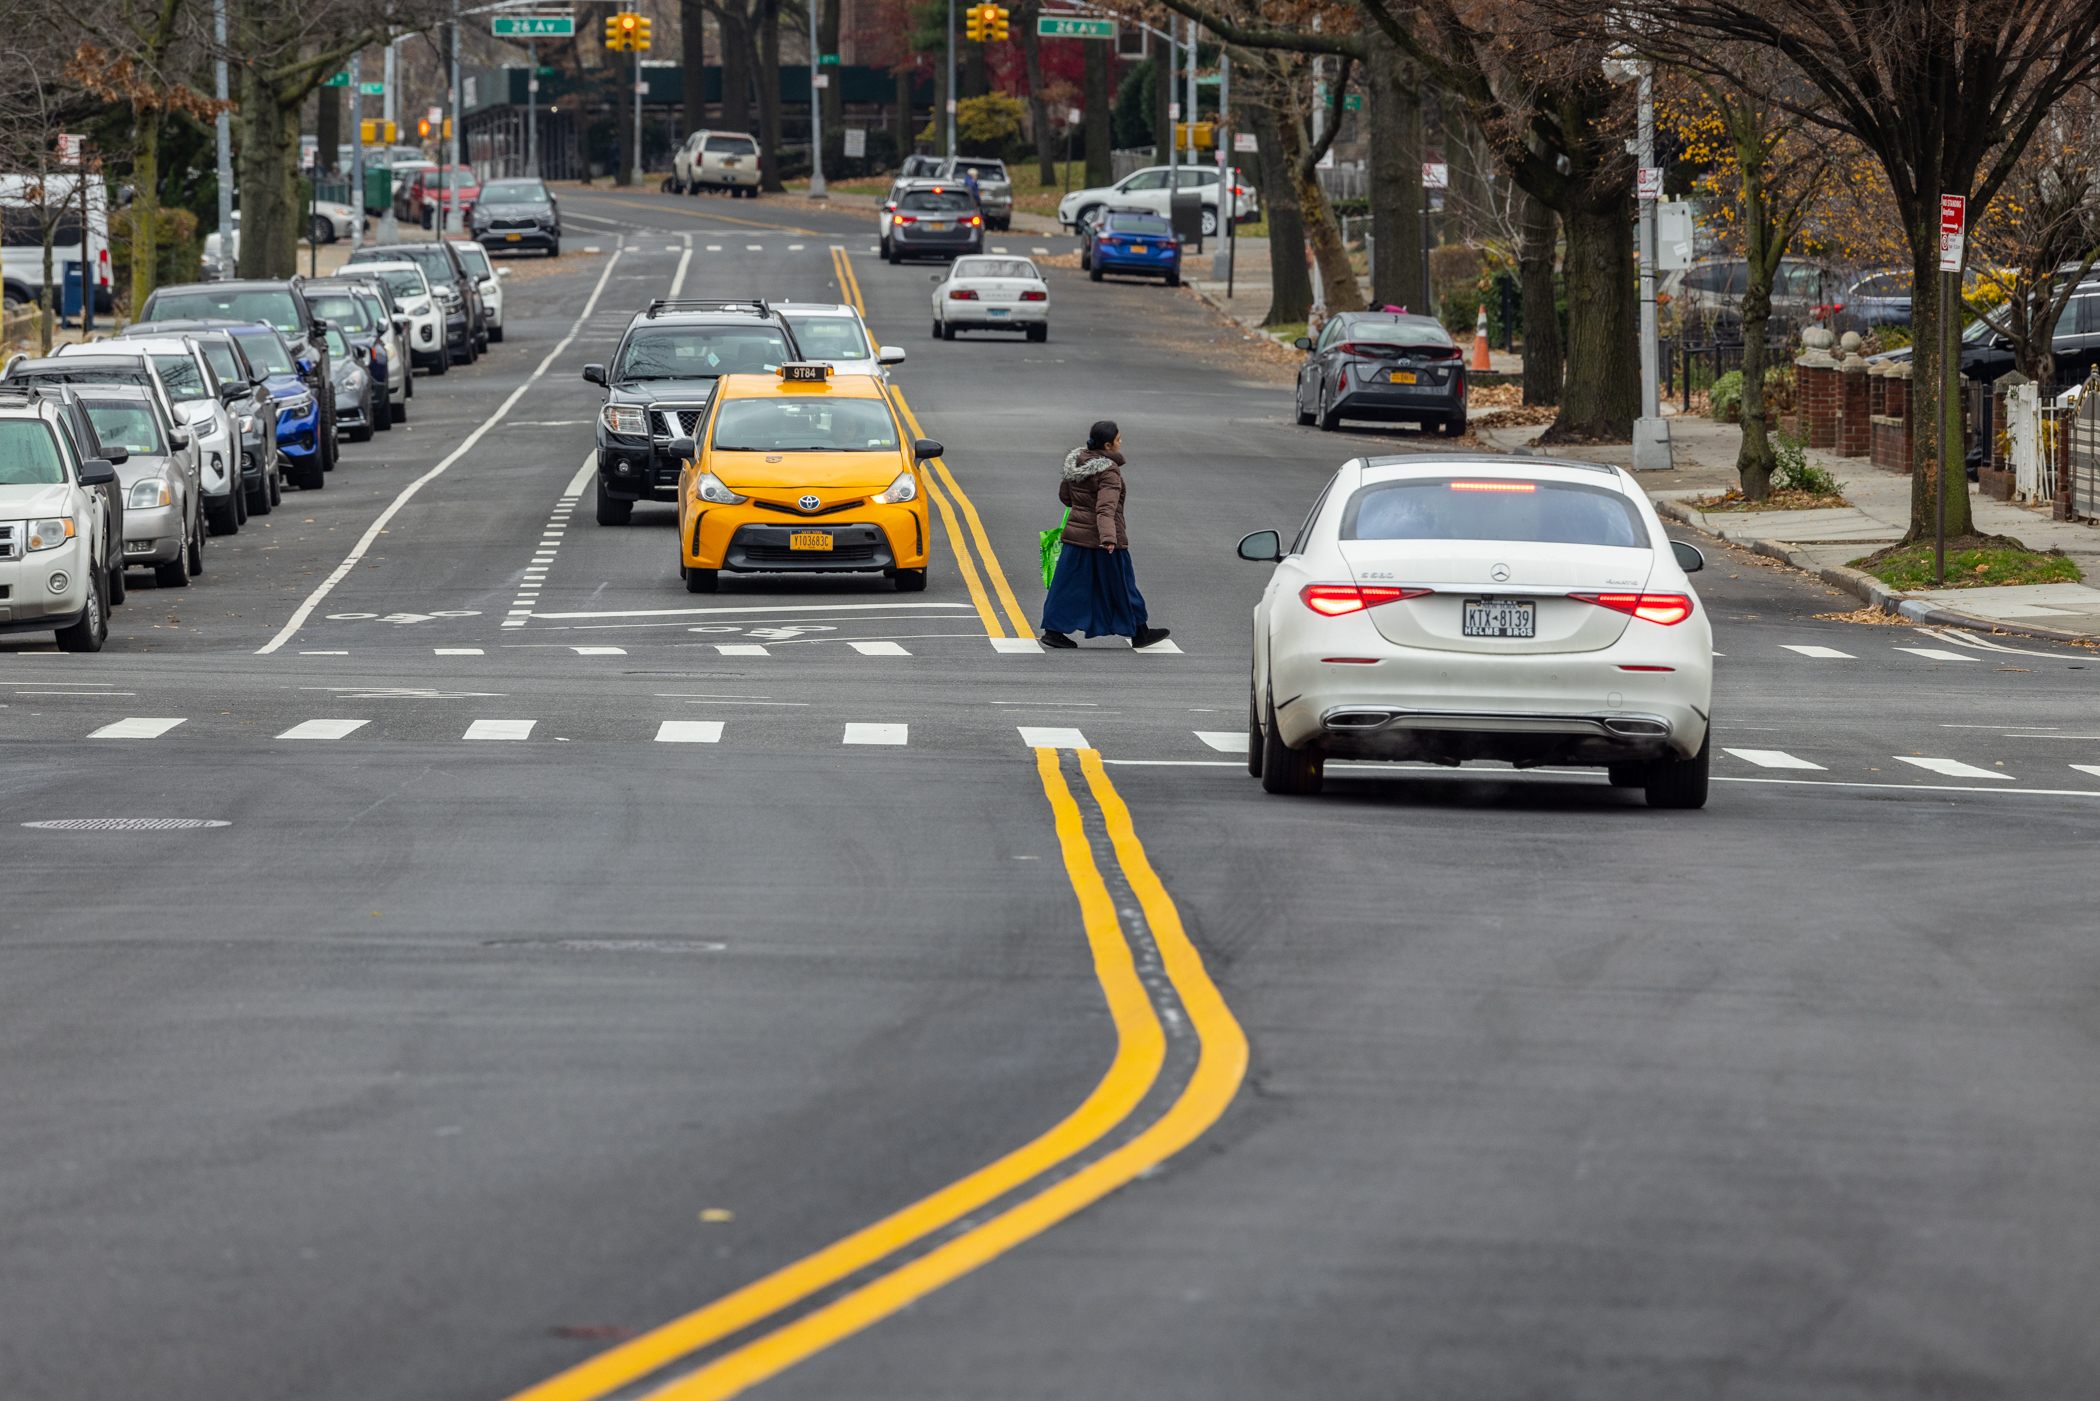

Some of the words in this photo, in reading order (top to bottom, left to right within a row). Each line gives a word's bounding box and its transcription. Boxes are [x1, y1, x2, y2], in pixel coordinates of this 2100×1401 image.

[511, 20, 531, 33] 26
[535, 20, 555, 33] Av
[1056, 20, 1074, 33] 26
[1078, 22, 1097, 35] Av
[1947, 199, 1962, 208] STANDING
[794, 367, 816, 378] 9T84
[794, 535, 829, 547] Y103683C
[1469, 609, 1491, 627] KTX
[1500, 609, 1530, 628] 8139
[1465, 627, 1500, 636] HELMS
